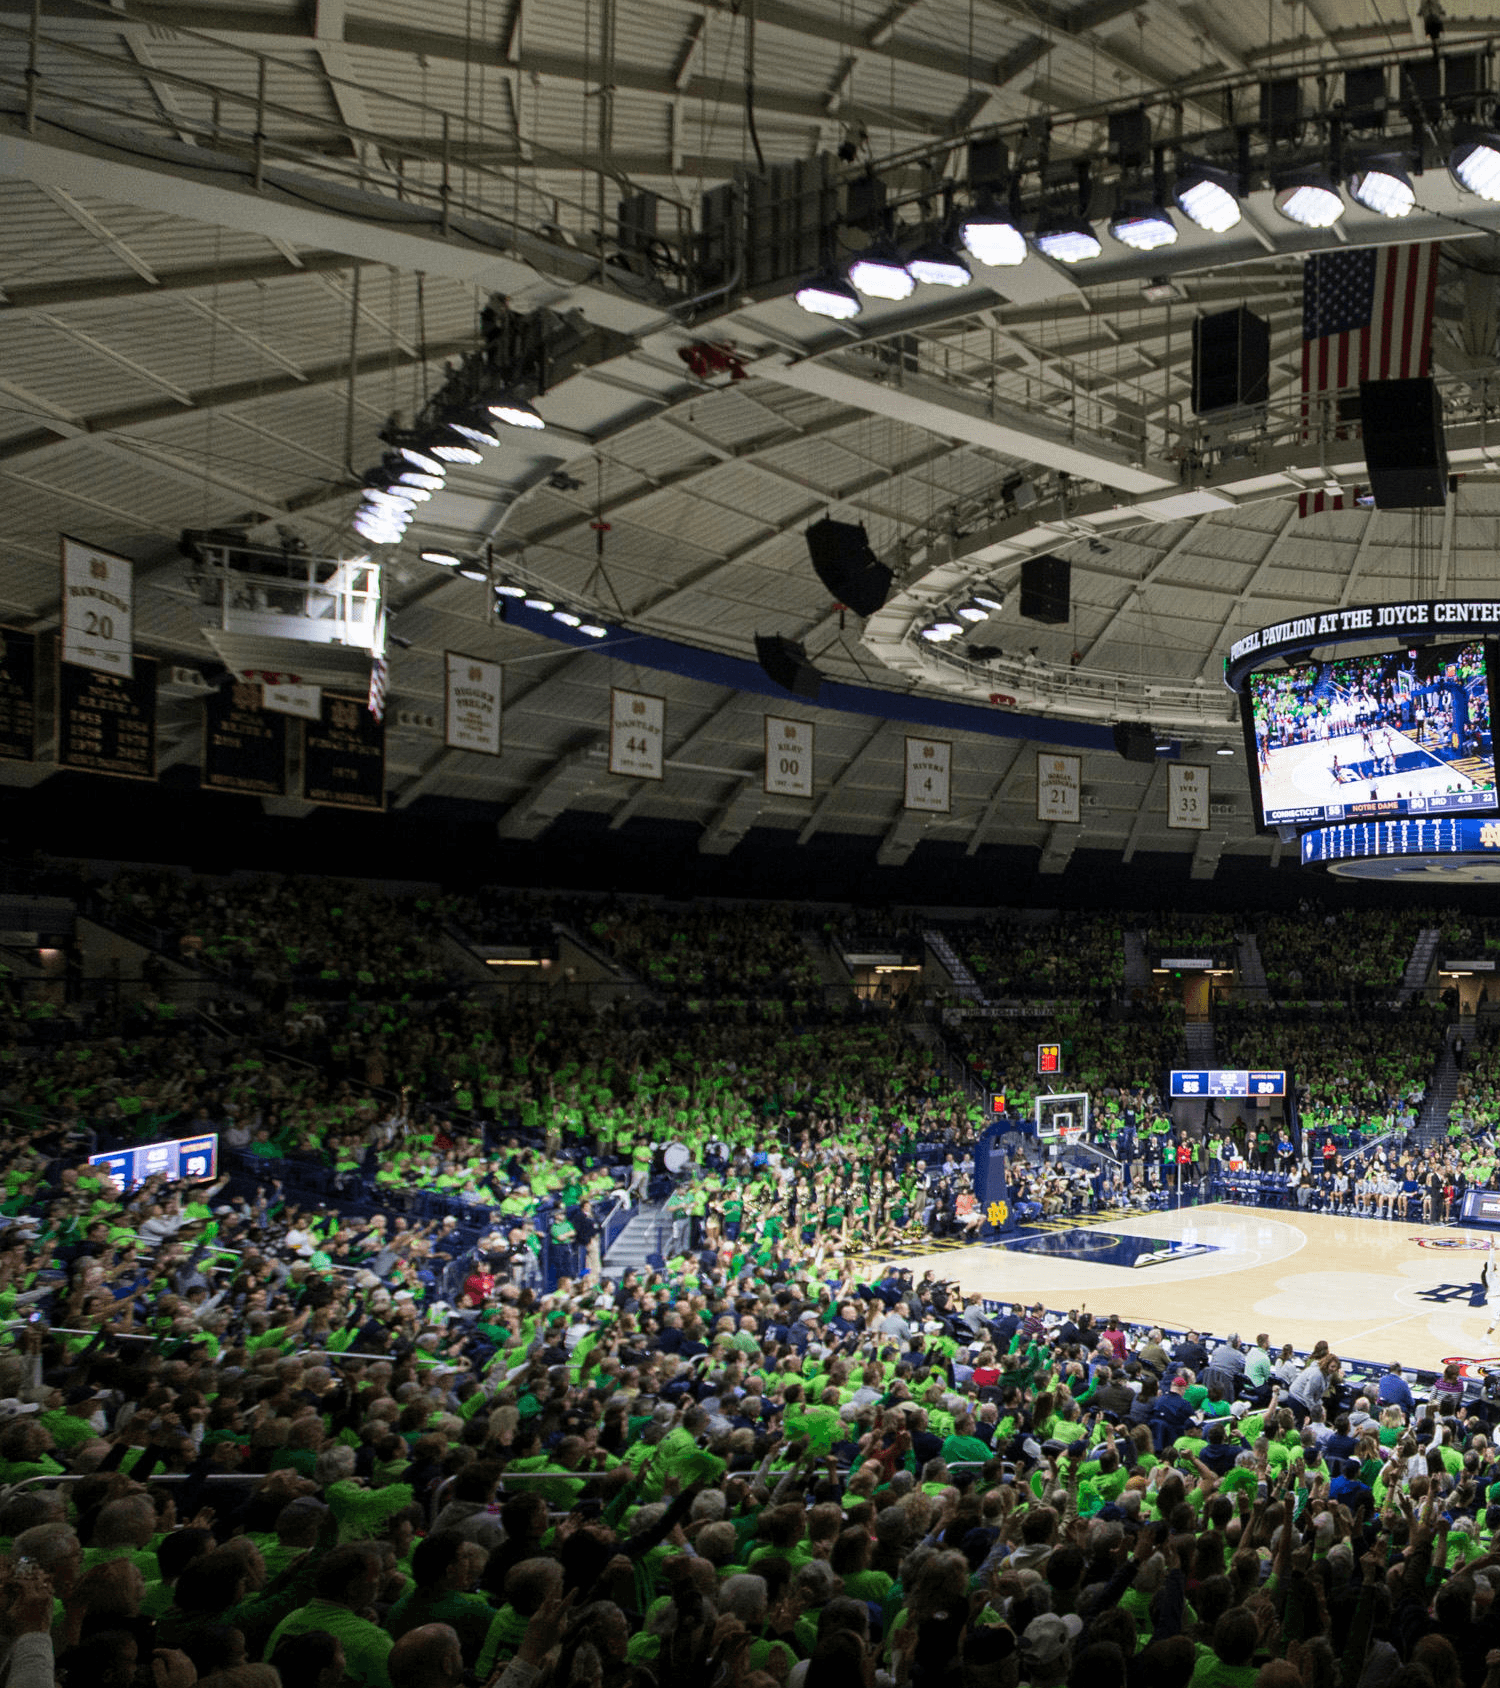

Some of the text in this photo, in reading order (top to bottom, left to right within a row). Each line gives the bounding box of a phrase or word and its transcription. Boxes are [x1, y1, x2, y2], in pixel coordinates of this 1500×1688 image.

[84, 610, 114, 640] 20
[1231, 631, 1261, 662] PURCELL
[1262, 617, 1316, 647] PAVILION
[1318, 613, 1339, 634] AT
[1340, 609, 1373, 630] THE
[1376, 603, 1429, 626] JOYCE
[626, 735, 648, 754] 44
[779, 757, 799, 776] 00
[923, 776, 932, 791] 4
[1051, 789, 1066, 804] 21
[1181, 797, 1197, 812] 33
[1271, 808, 1320, 819] CONNECTICUT
[1328, 805, 1341, 816] 55
[1352, 802, 1377, 812] NOTRE
[1377, 801, 1399, 810] DAME
[1410, 798, 1425, 809] 50
[1430, 797, 1447, 806] 3RD
[1483, 793, 1494, 802] 22
[1183, 1081, 1274, 1094] 55 50
[1135, 1243, 1207, 1267] ACC
